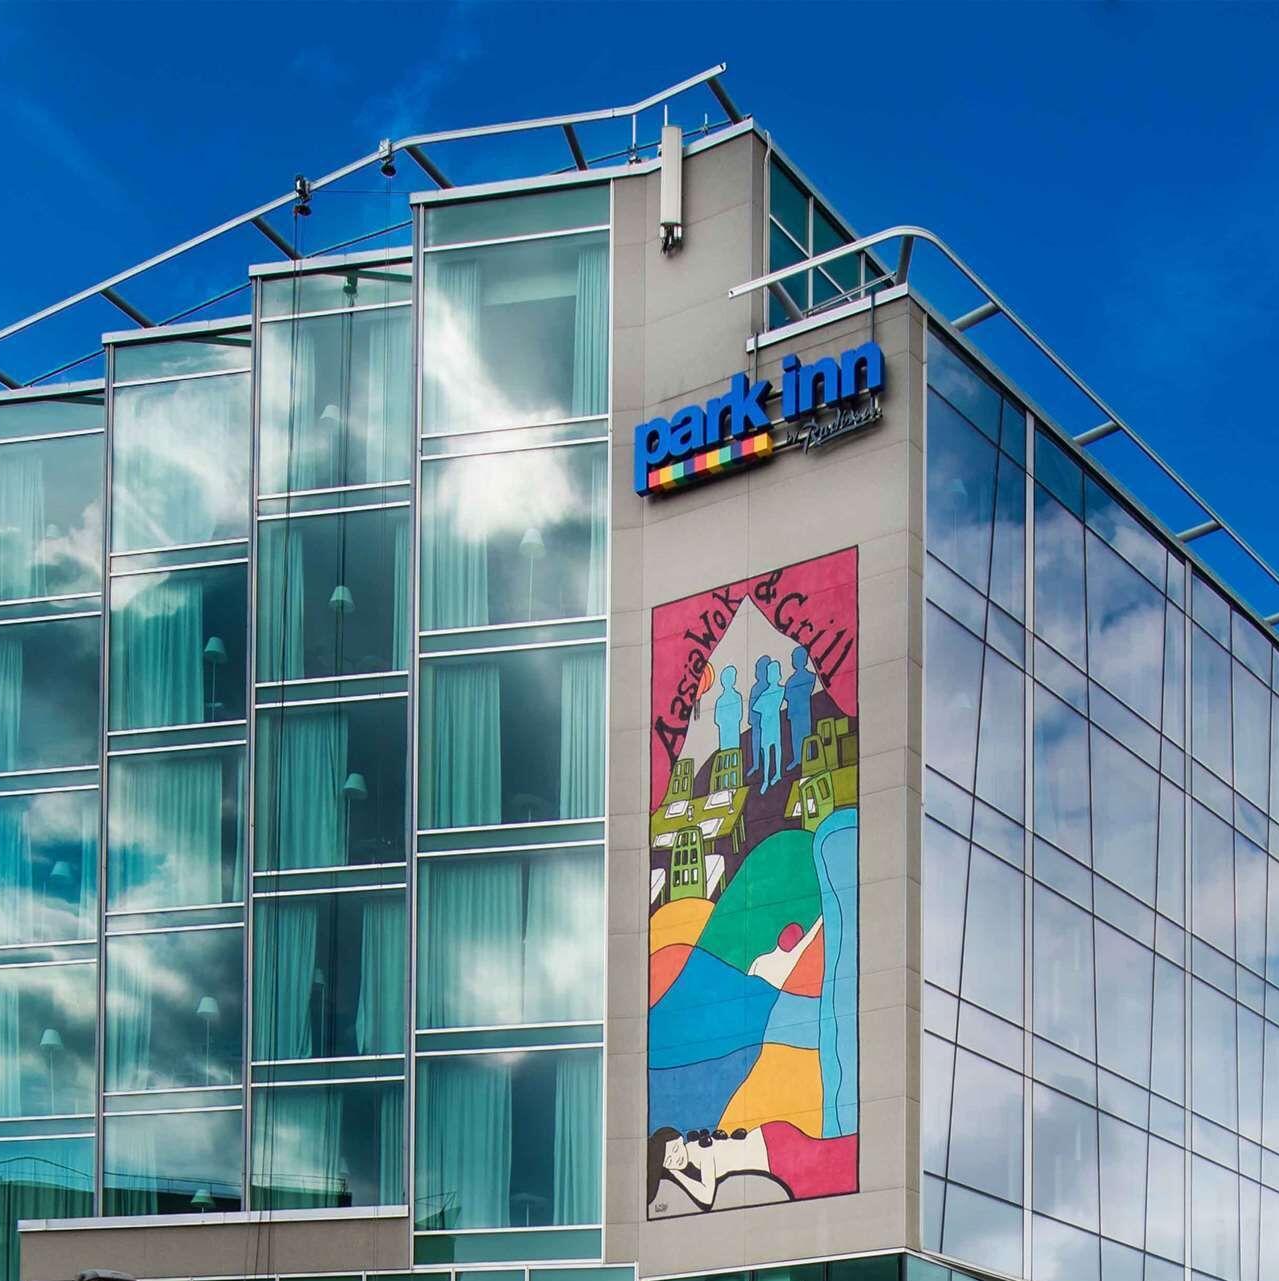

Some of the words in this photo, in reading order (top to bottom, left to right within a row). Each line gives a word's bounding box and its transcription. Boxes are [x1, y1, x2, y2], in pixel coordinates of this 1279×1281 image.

[634, 371, 773, 496] park
[782, 341, 886, 422] inn
[655, 648, 709, 767] Aasia
[754, 569, 783, 604] &
[775, 592, 854, 688] Grill
